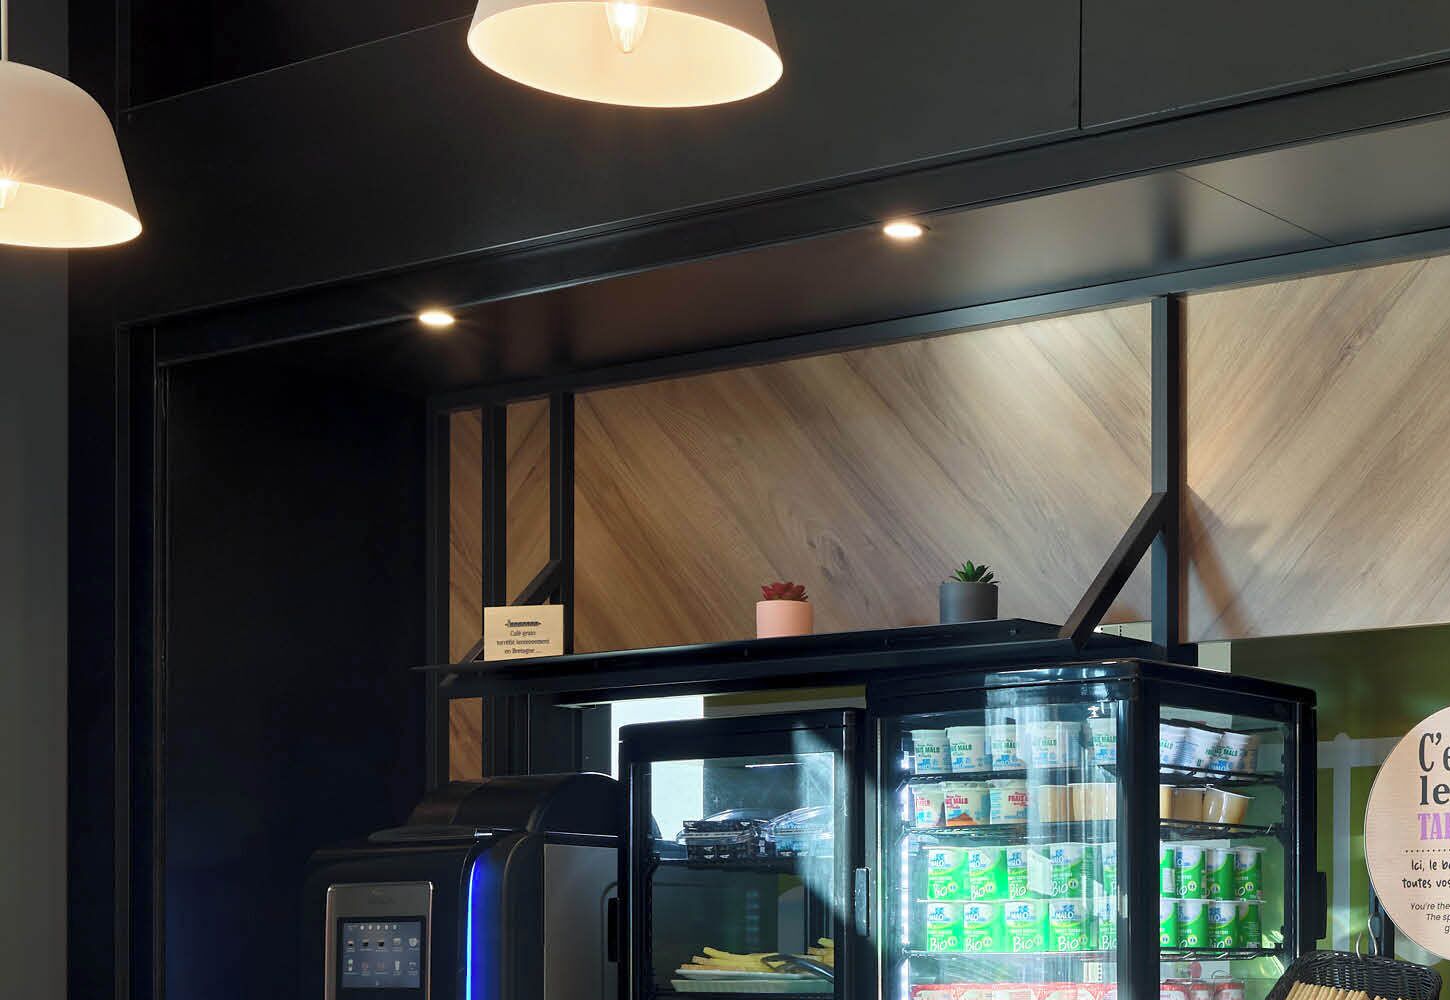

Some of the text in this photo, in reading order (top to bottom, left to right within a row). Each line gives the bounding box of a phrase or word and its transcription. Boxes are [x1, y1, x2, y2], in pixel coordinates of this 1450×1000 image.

[1420, 775, 1450, 805] le
[1411, 858, 1425, 872] Ici,
[1429, 859, 1437, 871] le
[1401, 877, 1432, 889] toutes
[1410, 902, 1436, 911] You're
[1437, 902, 1450, 910] the
[1426, 913, 1441, 921] The
[1058, 935, 1078, 951] Bio
